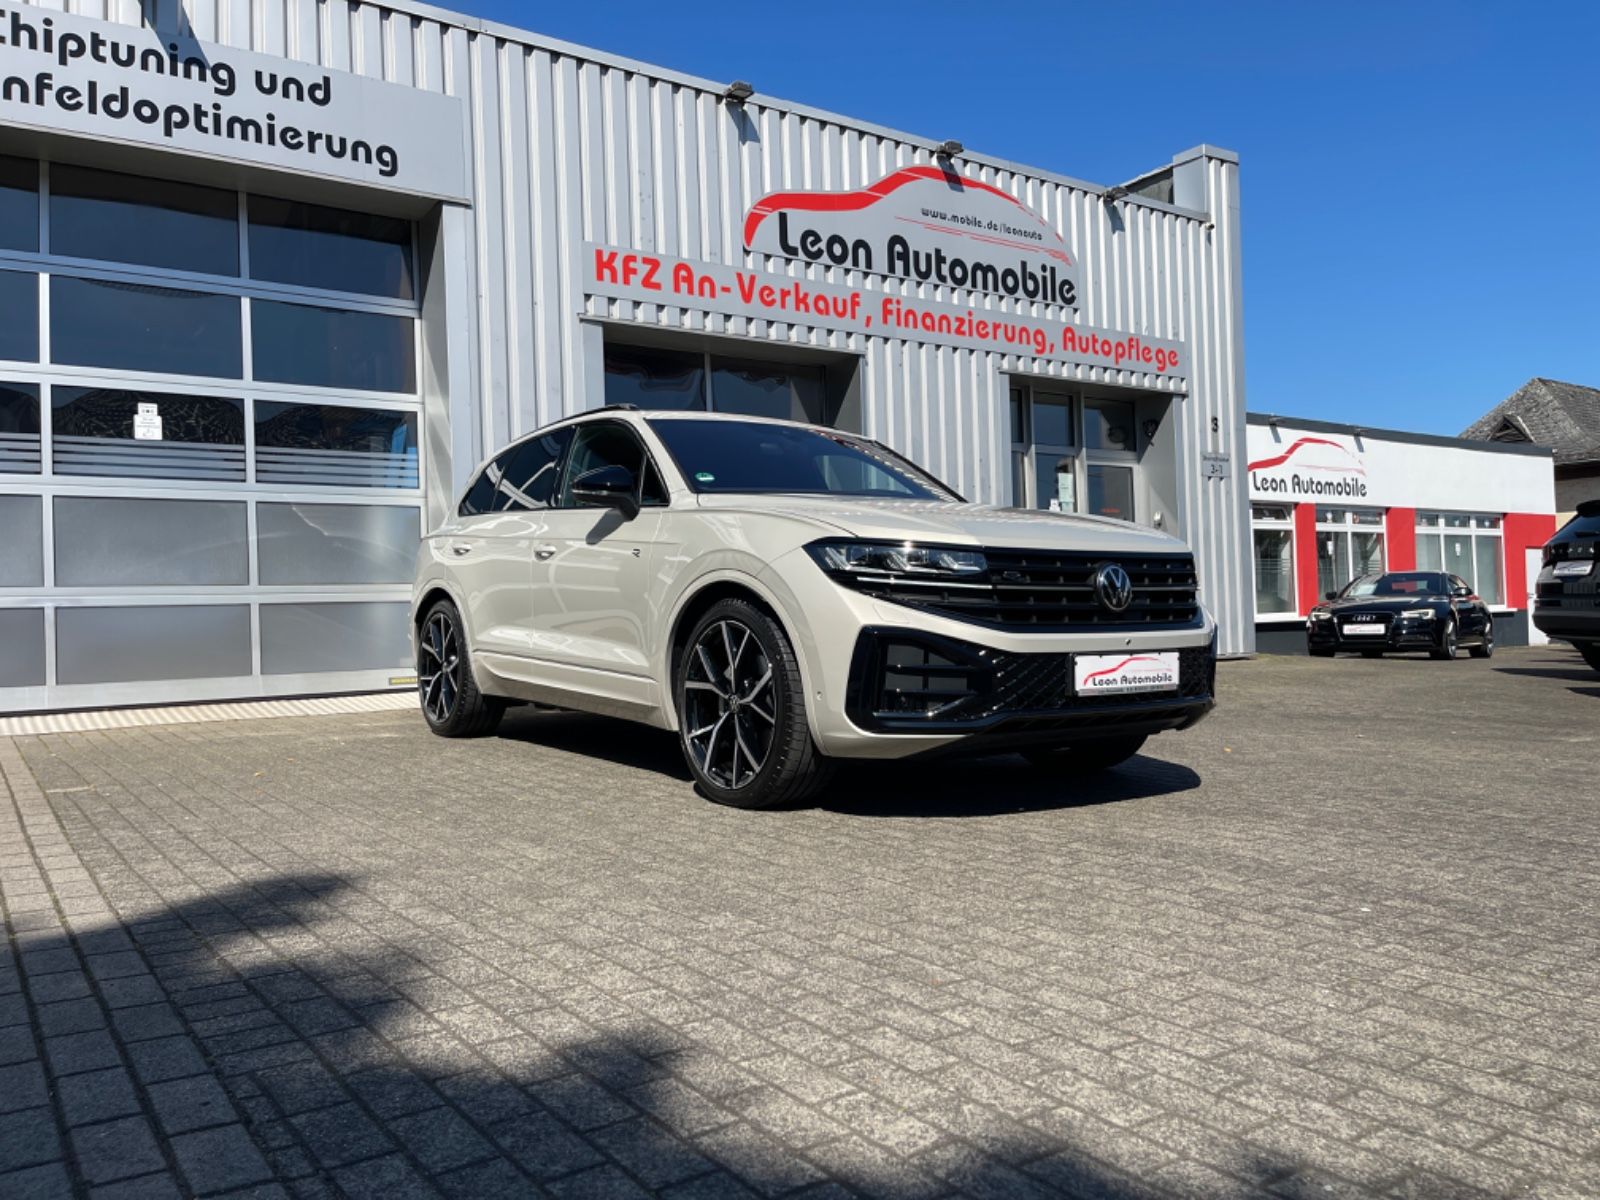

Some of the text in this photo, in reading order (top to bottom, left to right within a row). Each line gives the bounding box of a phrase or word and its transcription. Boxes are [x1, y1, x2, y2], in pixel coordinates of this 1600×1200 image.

[0, 9, 331, 106] hiptuning und
[3, 72, 398, 177] nfeldoptimierung
[778, 211, 1077, 305] Leon Automobile
[882, 297, 1055, 355] Finanzierung,
[1063, 326, 1179, 372] Autopflege
[1253, 471, 1368, 497] Leon Automobile
[1092, 673, 1173, 686] Leon Automobile
